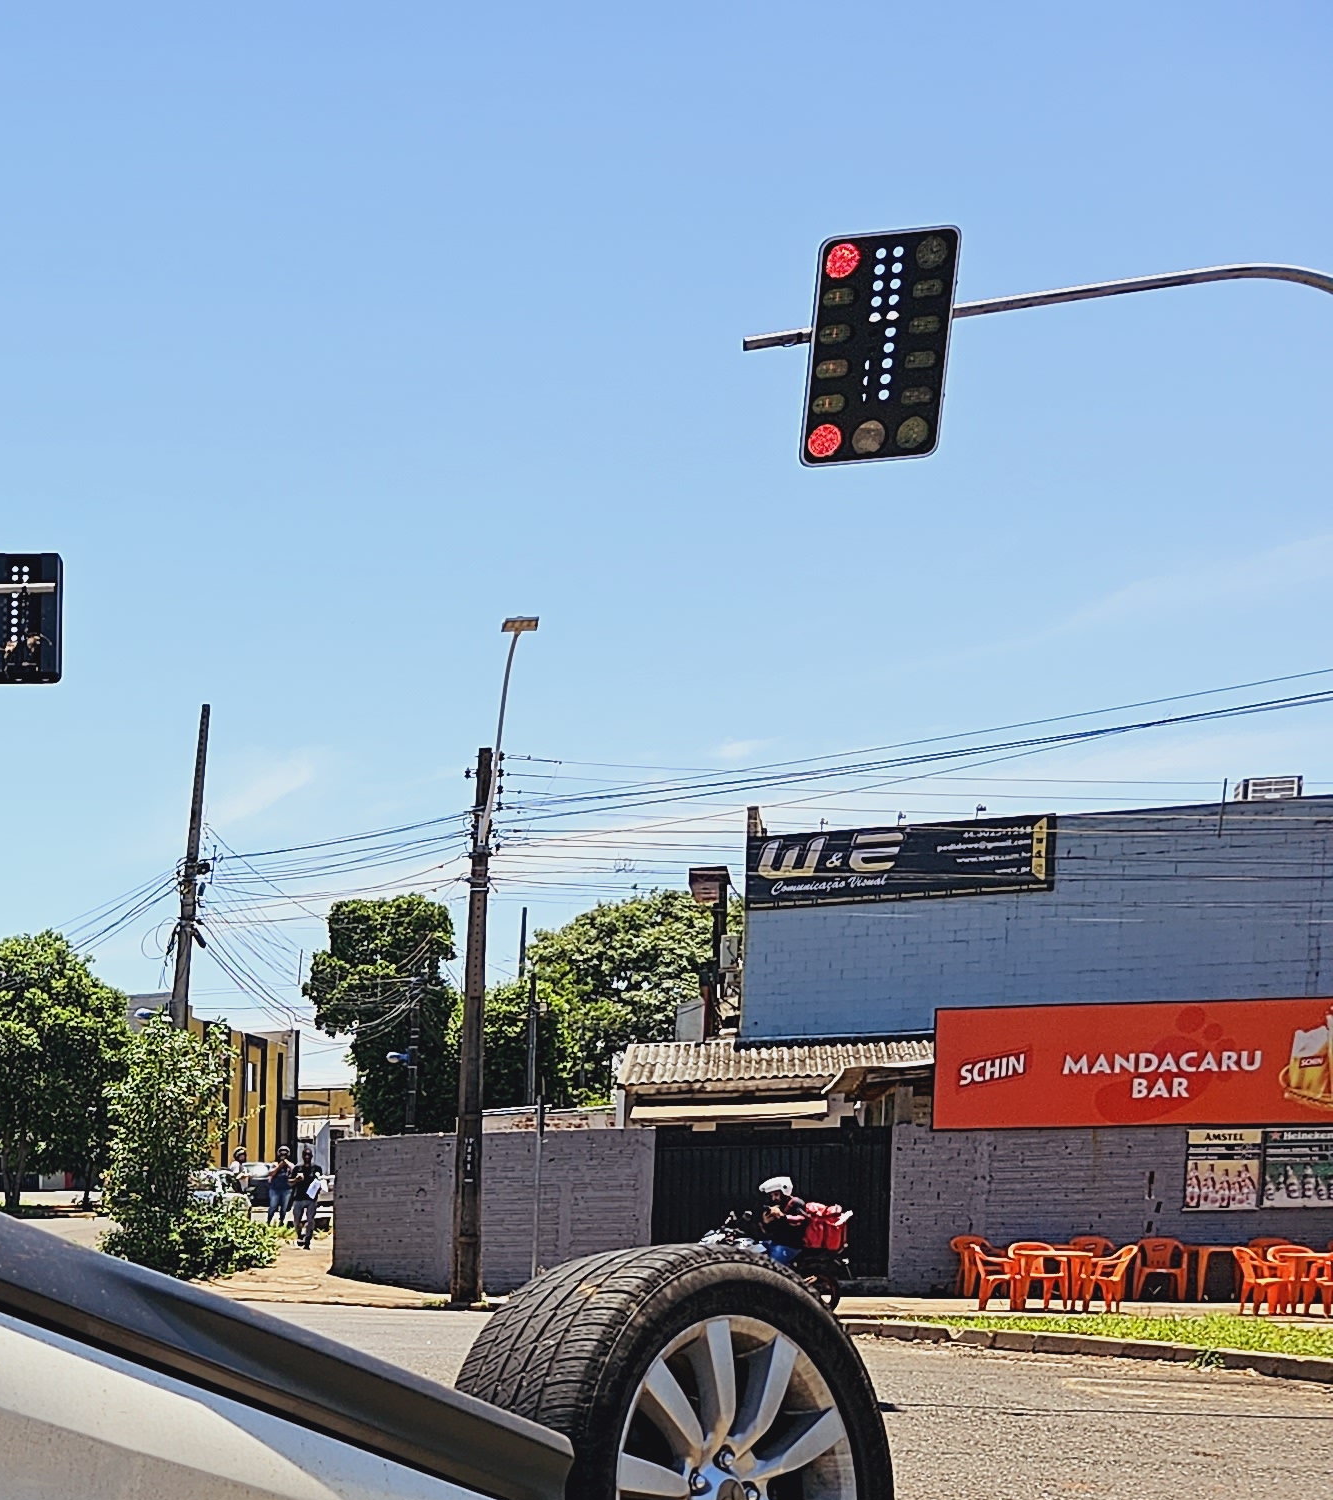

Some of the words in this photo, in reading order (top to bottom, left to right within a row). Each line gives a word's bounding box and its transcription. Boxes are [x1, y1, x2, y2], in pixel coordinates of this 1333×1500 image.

[755, 836, 829, 879] W
[826, 852, 843, 868] &
[770, 877, 846, 896] Comunicação
[847, 873, 888, 888] Visual
[958, 1053, 1026, 1086] SCHIN
[1061, 1050, 1262, 1075] MANDACARU
[1131, 1077, 1190, 1099] BAR
[1204, 1132, 1245, 1141] AMSTEL
